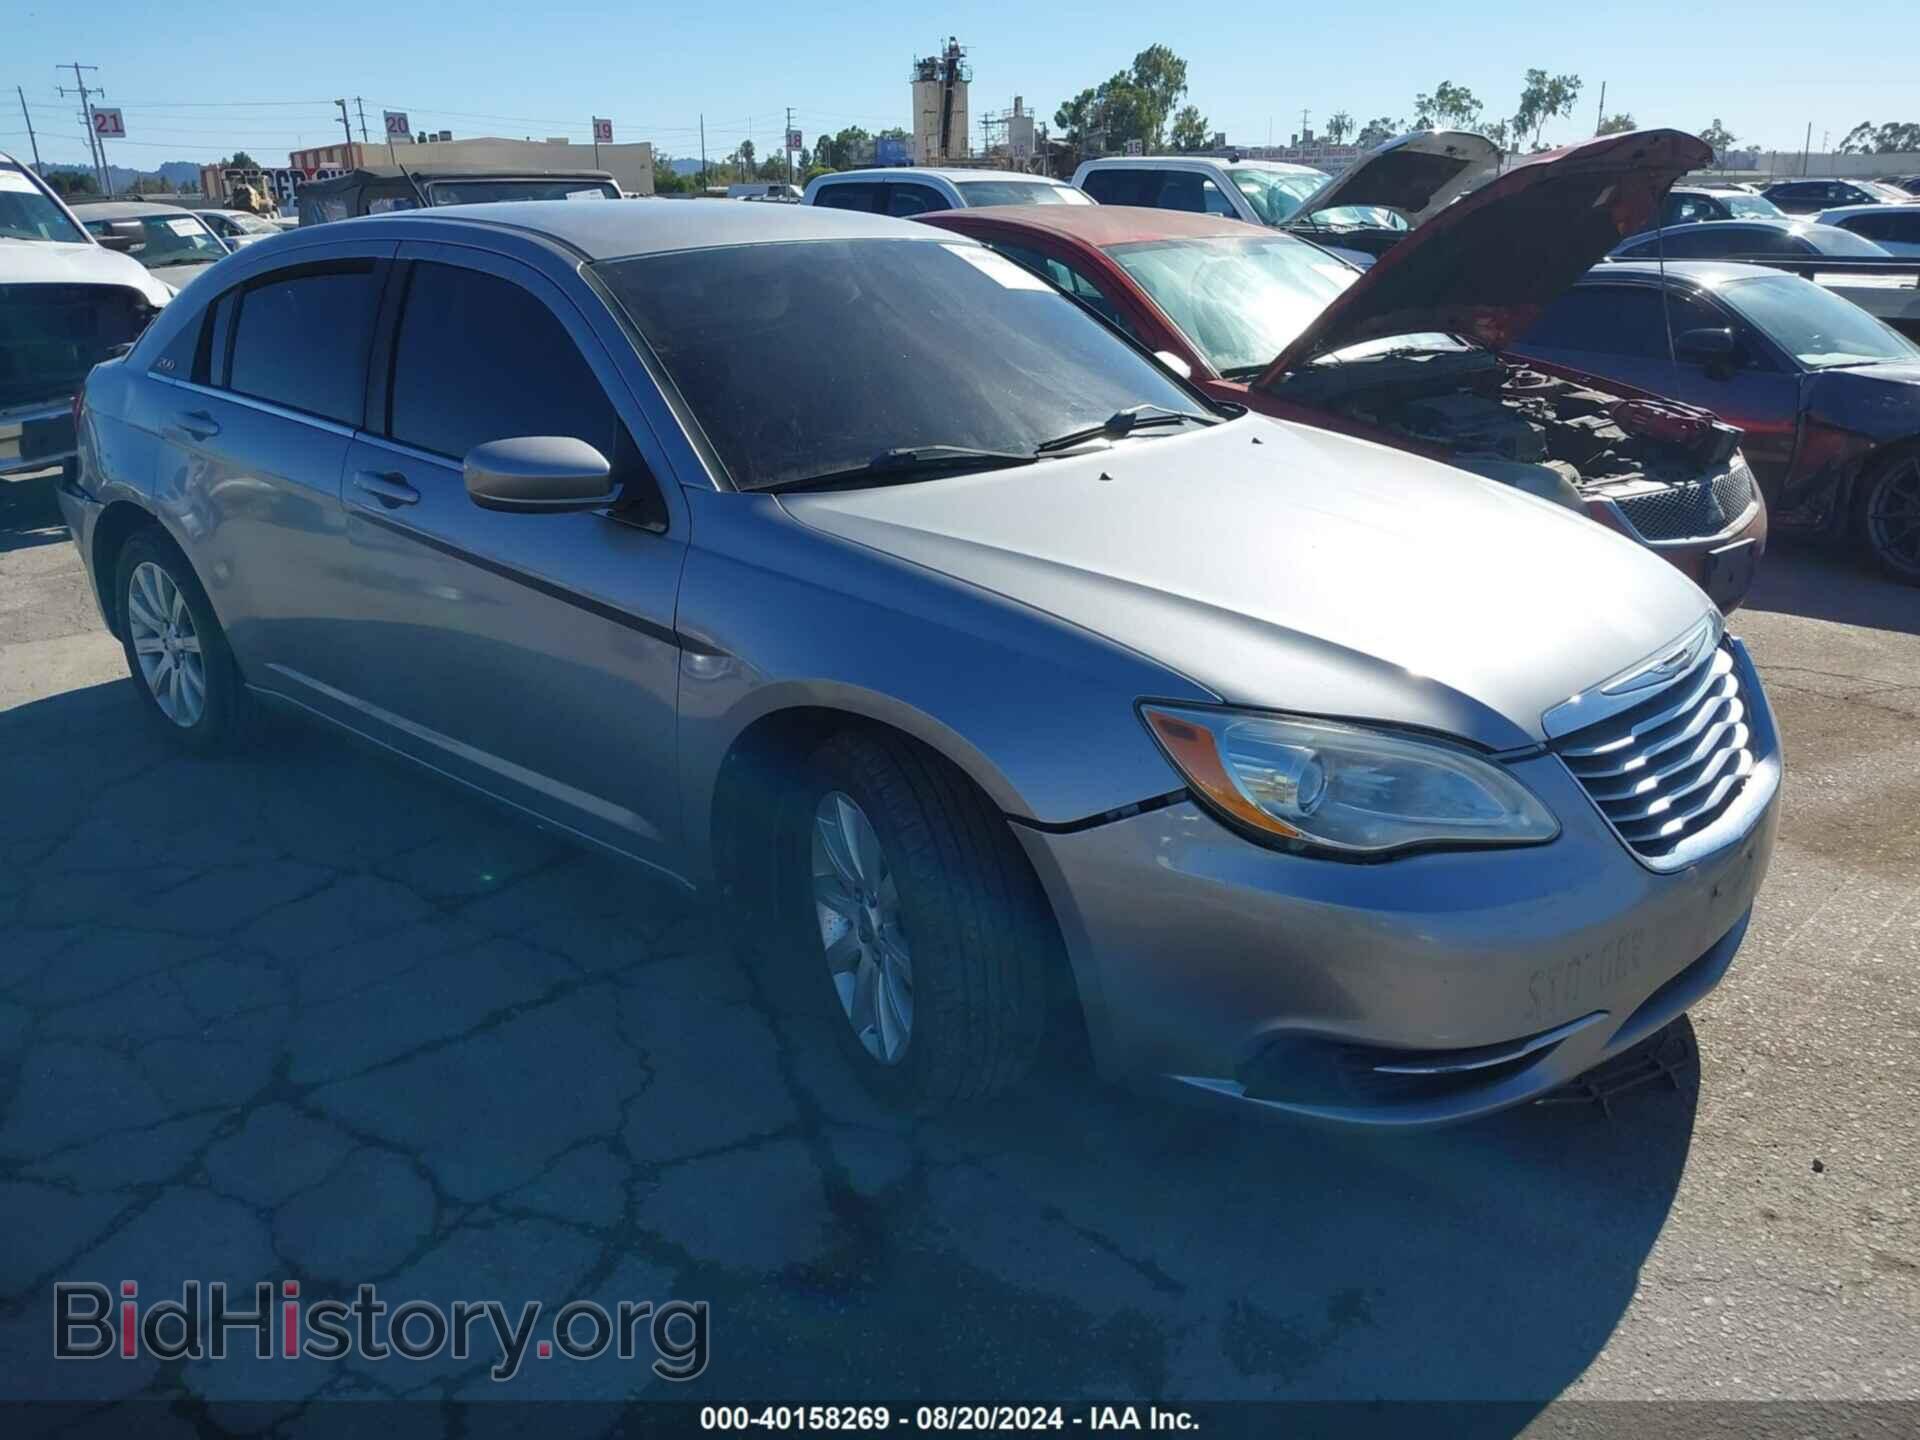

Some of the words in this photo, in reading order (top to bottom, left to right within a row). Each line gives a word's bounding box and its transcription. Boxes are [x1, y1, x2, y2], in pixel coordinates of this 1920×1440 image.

[95, 113, 124, 133] 21
[386, 116, 409, 134] 20
[594, 123, 612, 138] 19
